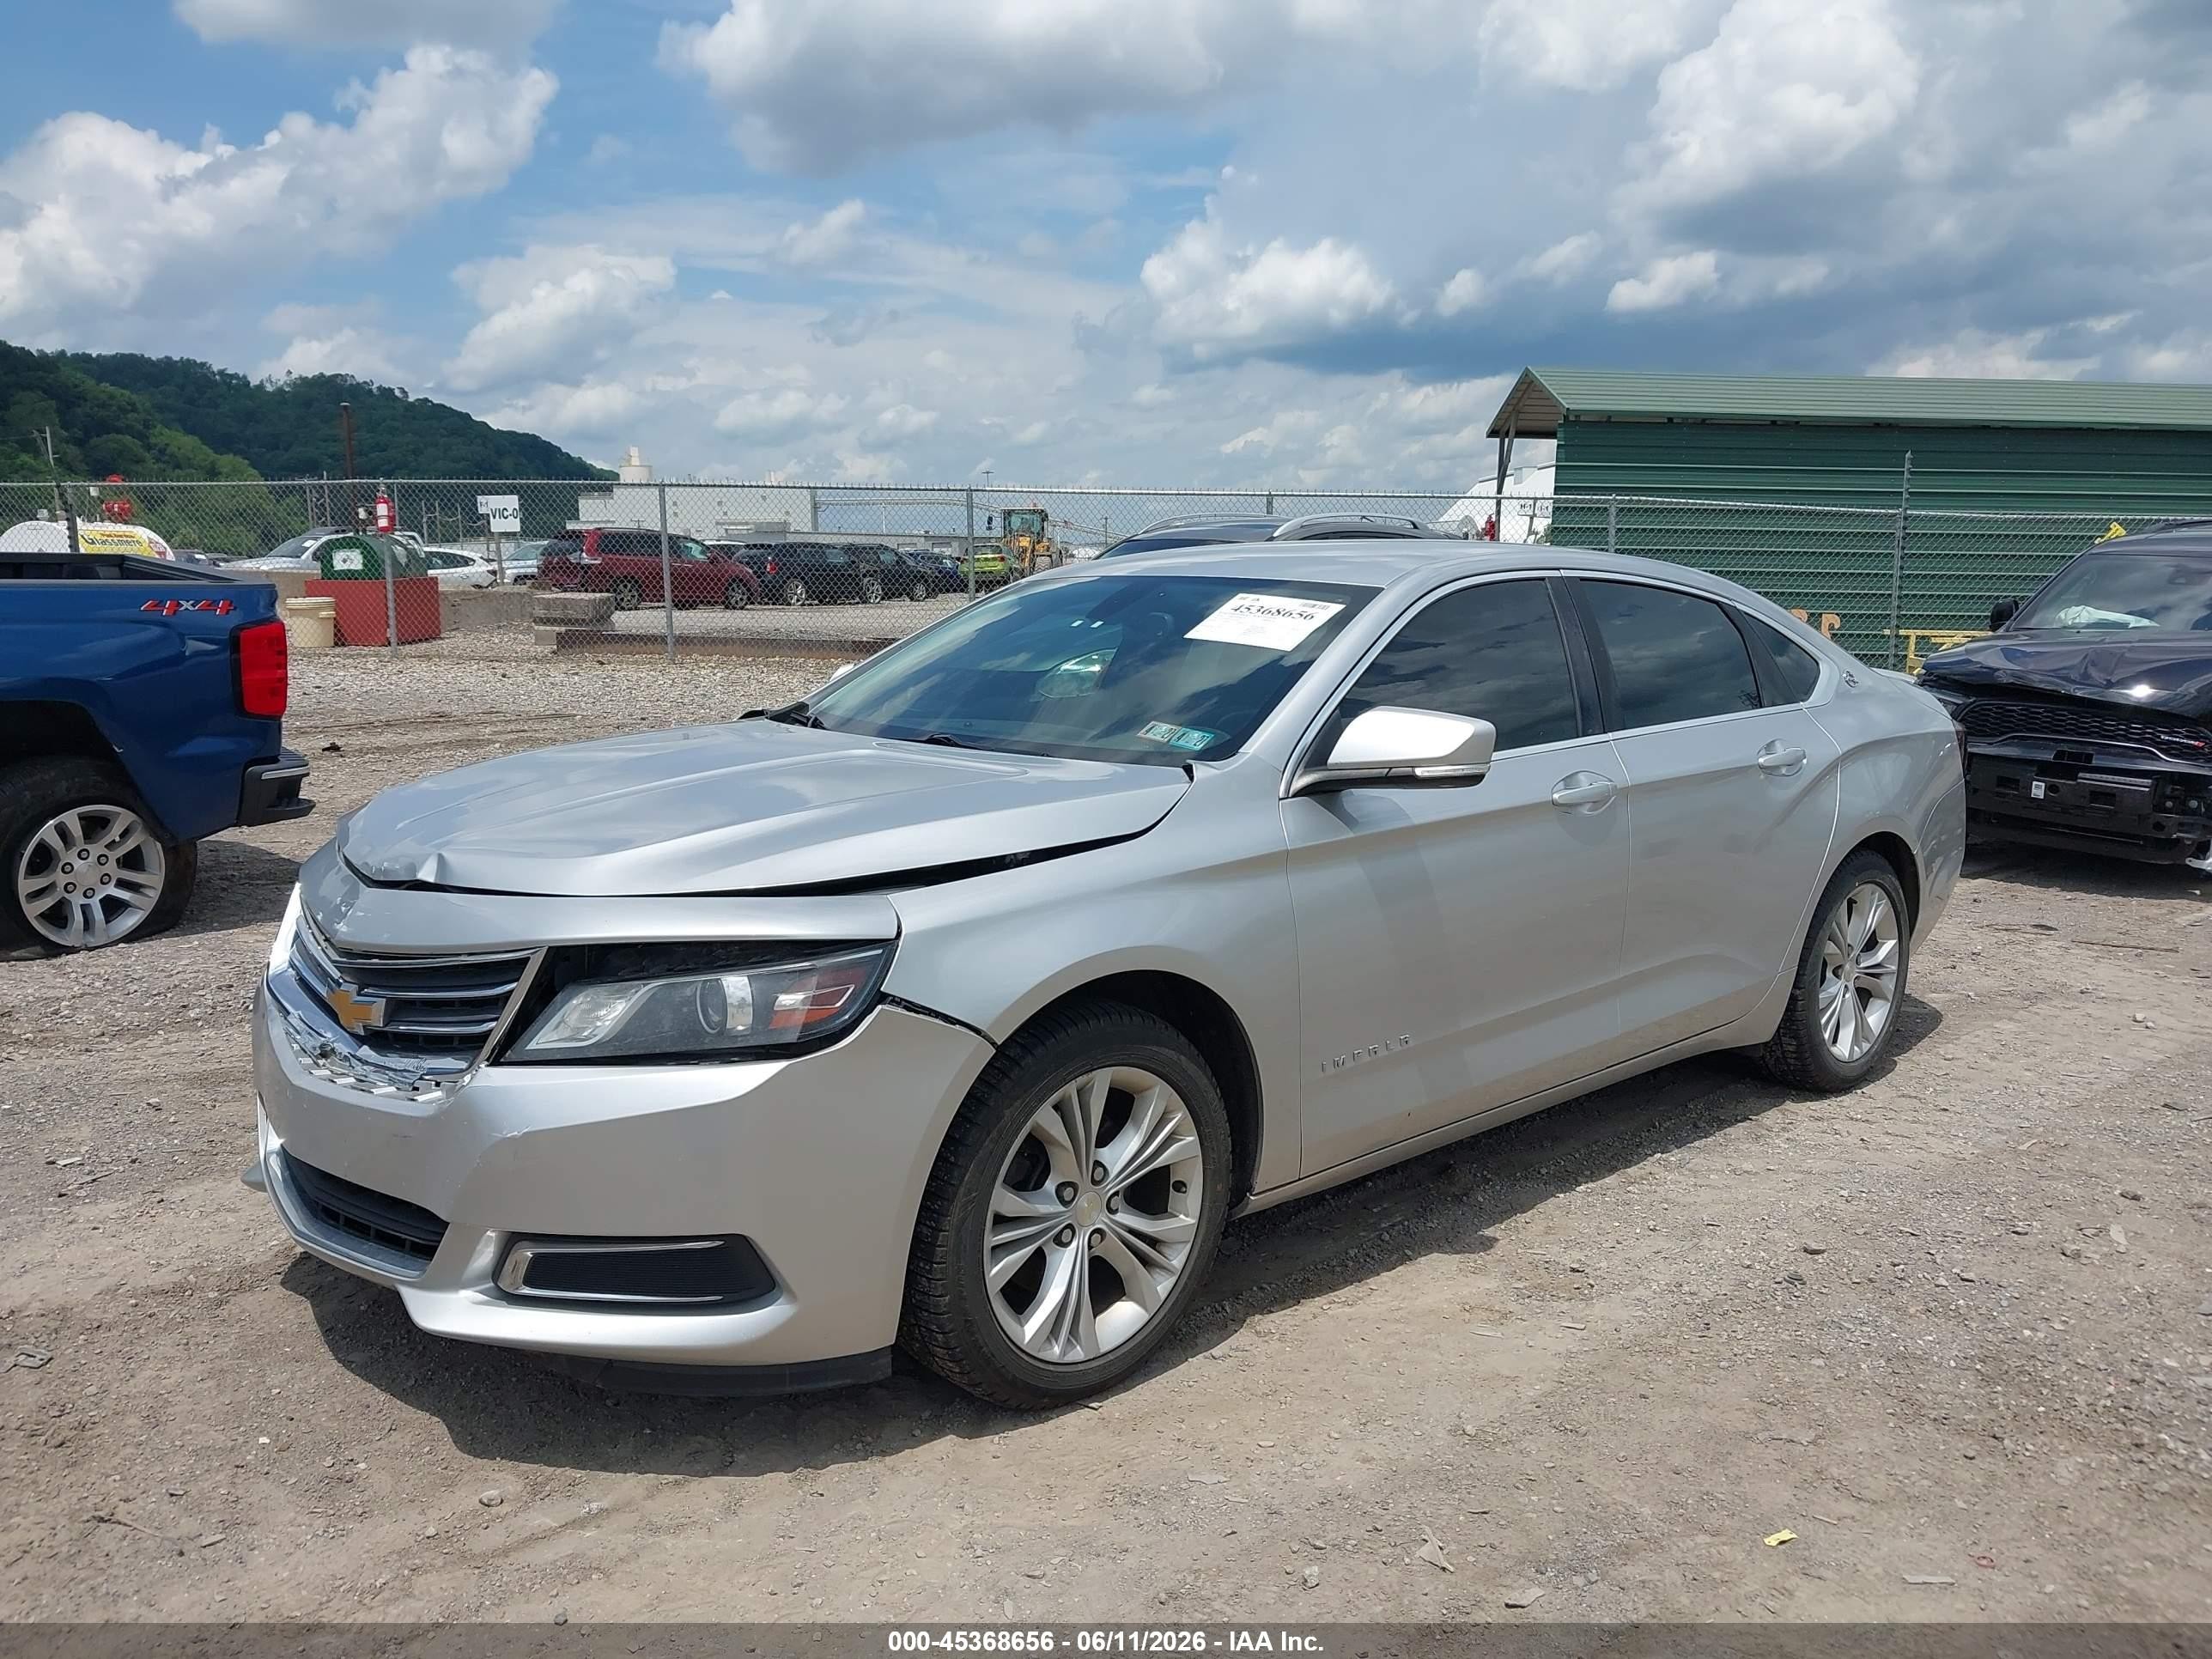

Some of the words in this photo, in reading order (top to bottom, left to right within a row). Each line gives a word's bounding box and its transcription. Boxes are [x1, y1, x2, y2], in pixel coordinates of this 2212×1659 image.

[78, 532, 144, 547] Glassmere
[1231, 603, 1319, 622] 45368656
[1321, 1034, 1411, 1073] IMPALA
